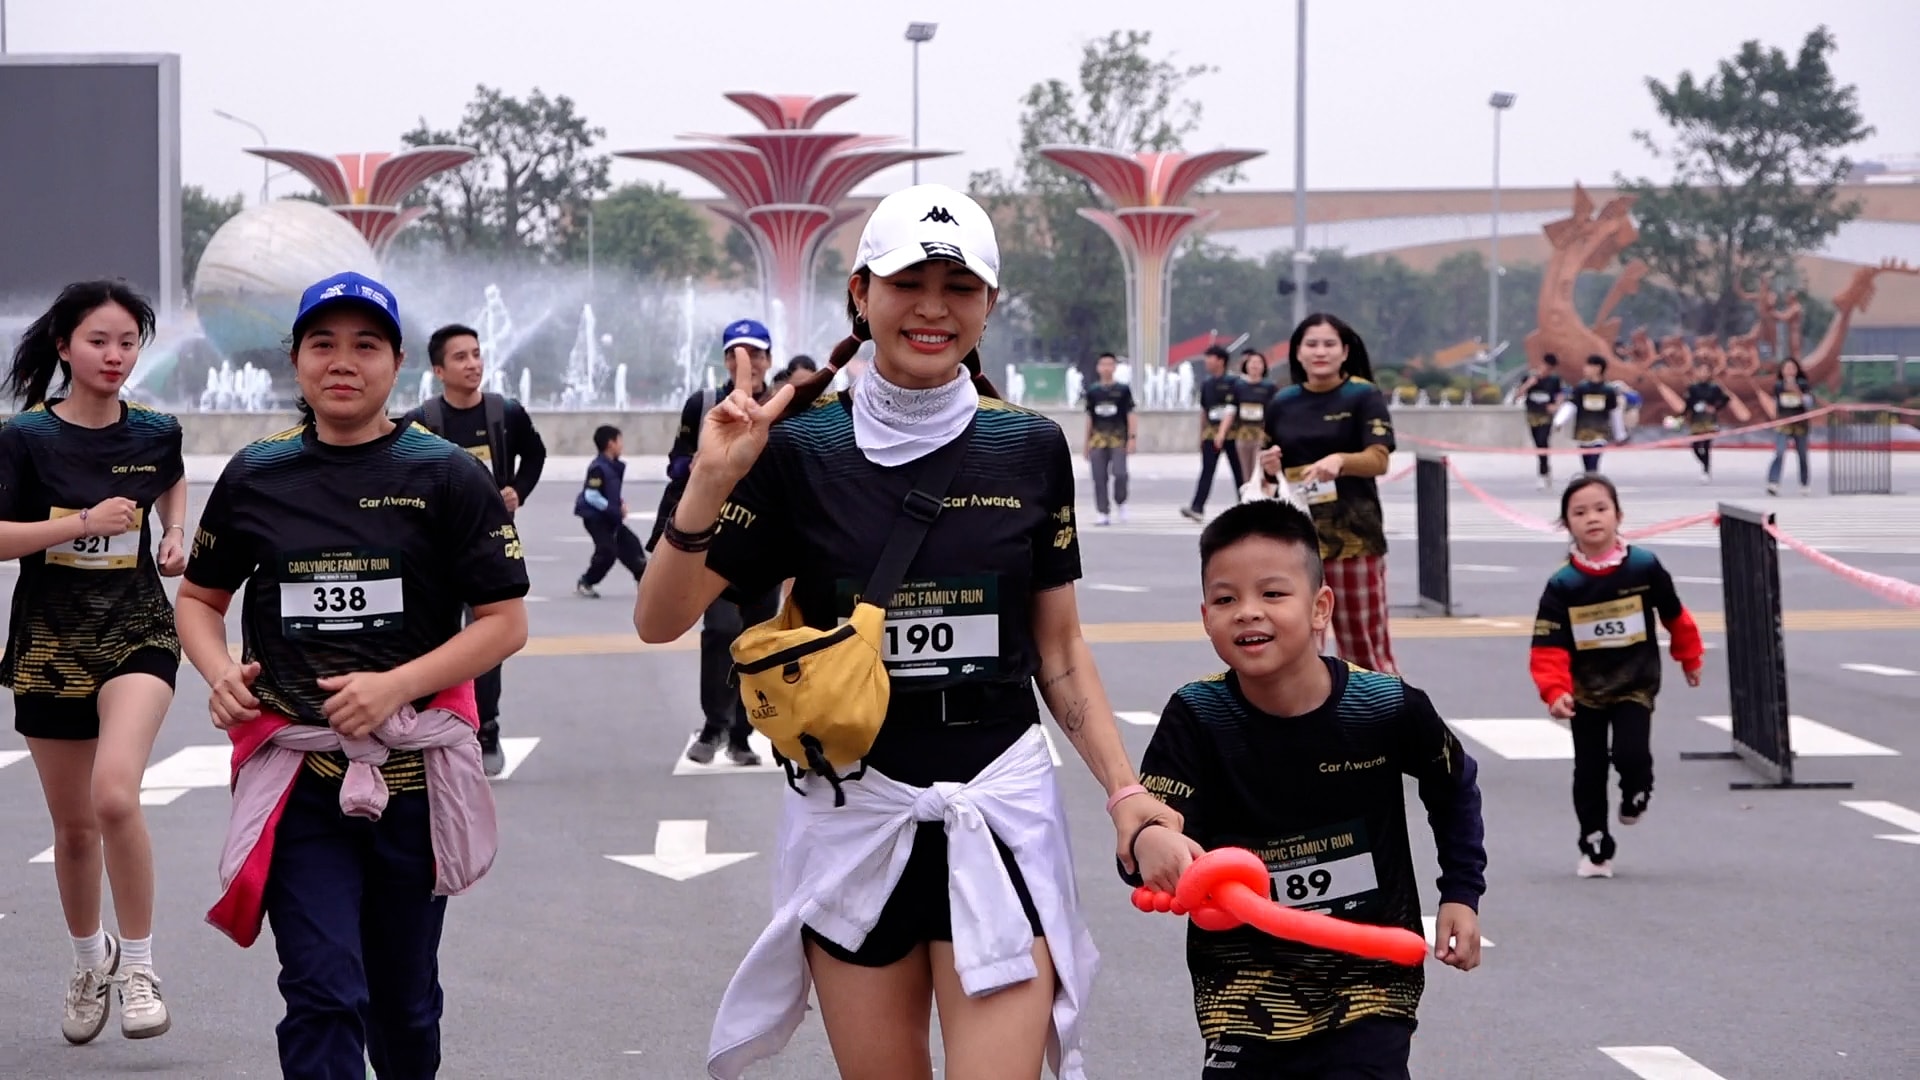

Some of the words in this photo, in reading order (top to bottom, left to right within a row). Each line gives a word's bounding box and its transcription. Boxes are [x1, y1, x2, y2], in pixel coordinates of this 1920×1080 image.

[359, 497, 381, 509] Car
[382, 496, 426, 509] Awards
[942, 496, 968, 508] Car
[970, 493, 1022, 509] Awards
[720, 501, 757, 529] ILITY
[73, 536, 111, 554] 521
[289, 560, 337, 574] CARLYMPIC
[338, 558, 369, 572] FAMILY
[371, 557, 390, 571] RUN
[314, 586, 367, 612] 338
[918, 590, 958, 606] FAMILY
[960, 588, 984, 604] RUN
[1594, 621, 1626, 636] 653
[885, 622, 954, 656] 190
[1319, 762, 1341, 773] Car
[1344, 755, 1386, 772] Awards
[1142, 774, 1196, 799] MOBILITY
[1289, 838, 1328, 858] FAMILY
[1330, 832, 1354, 850] RUN
